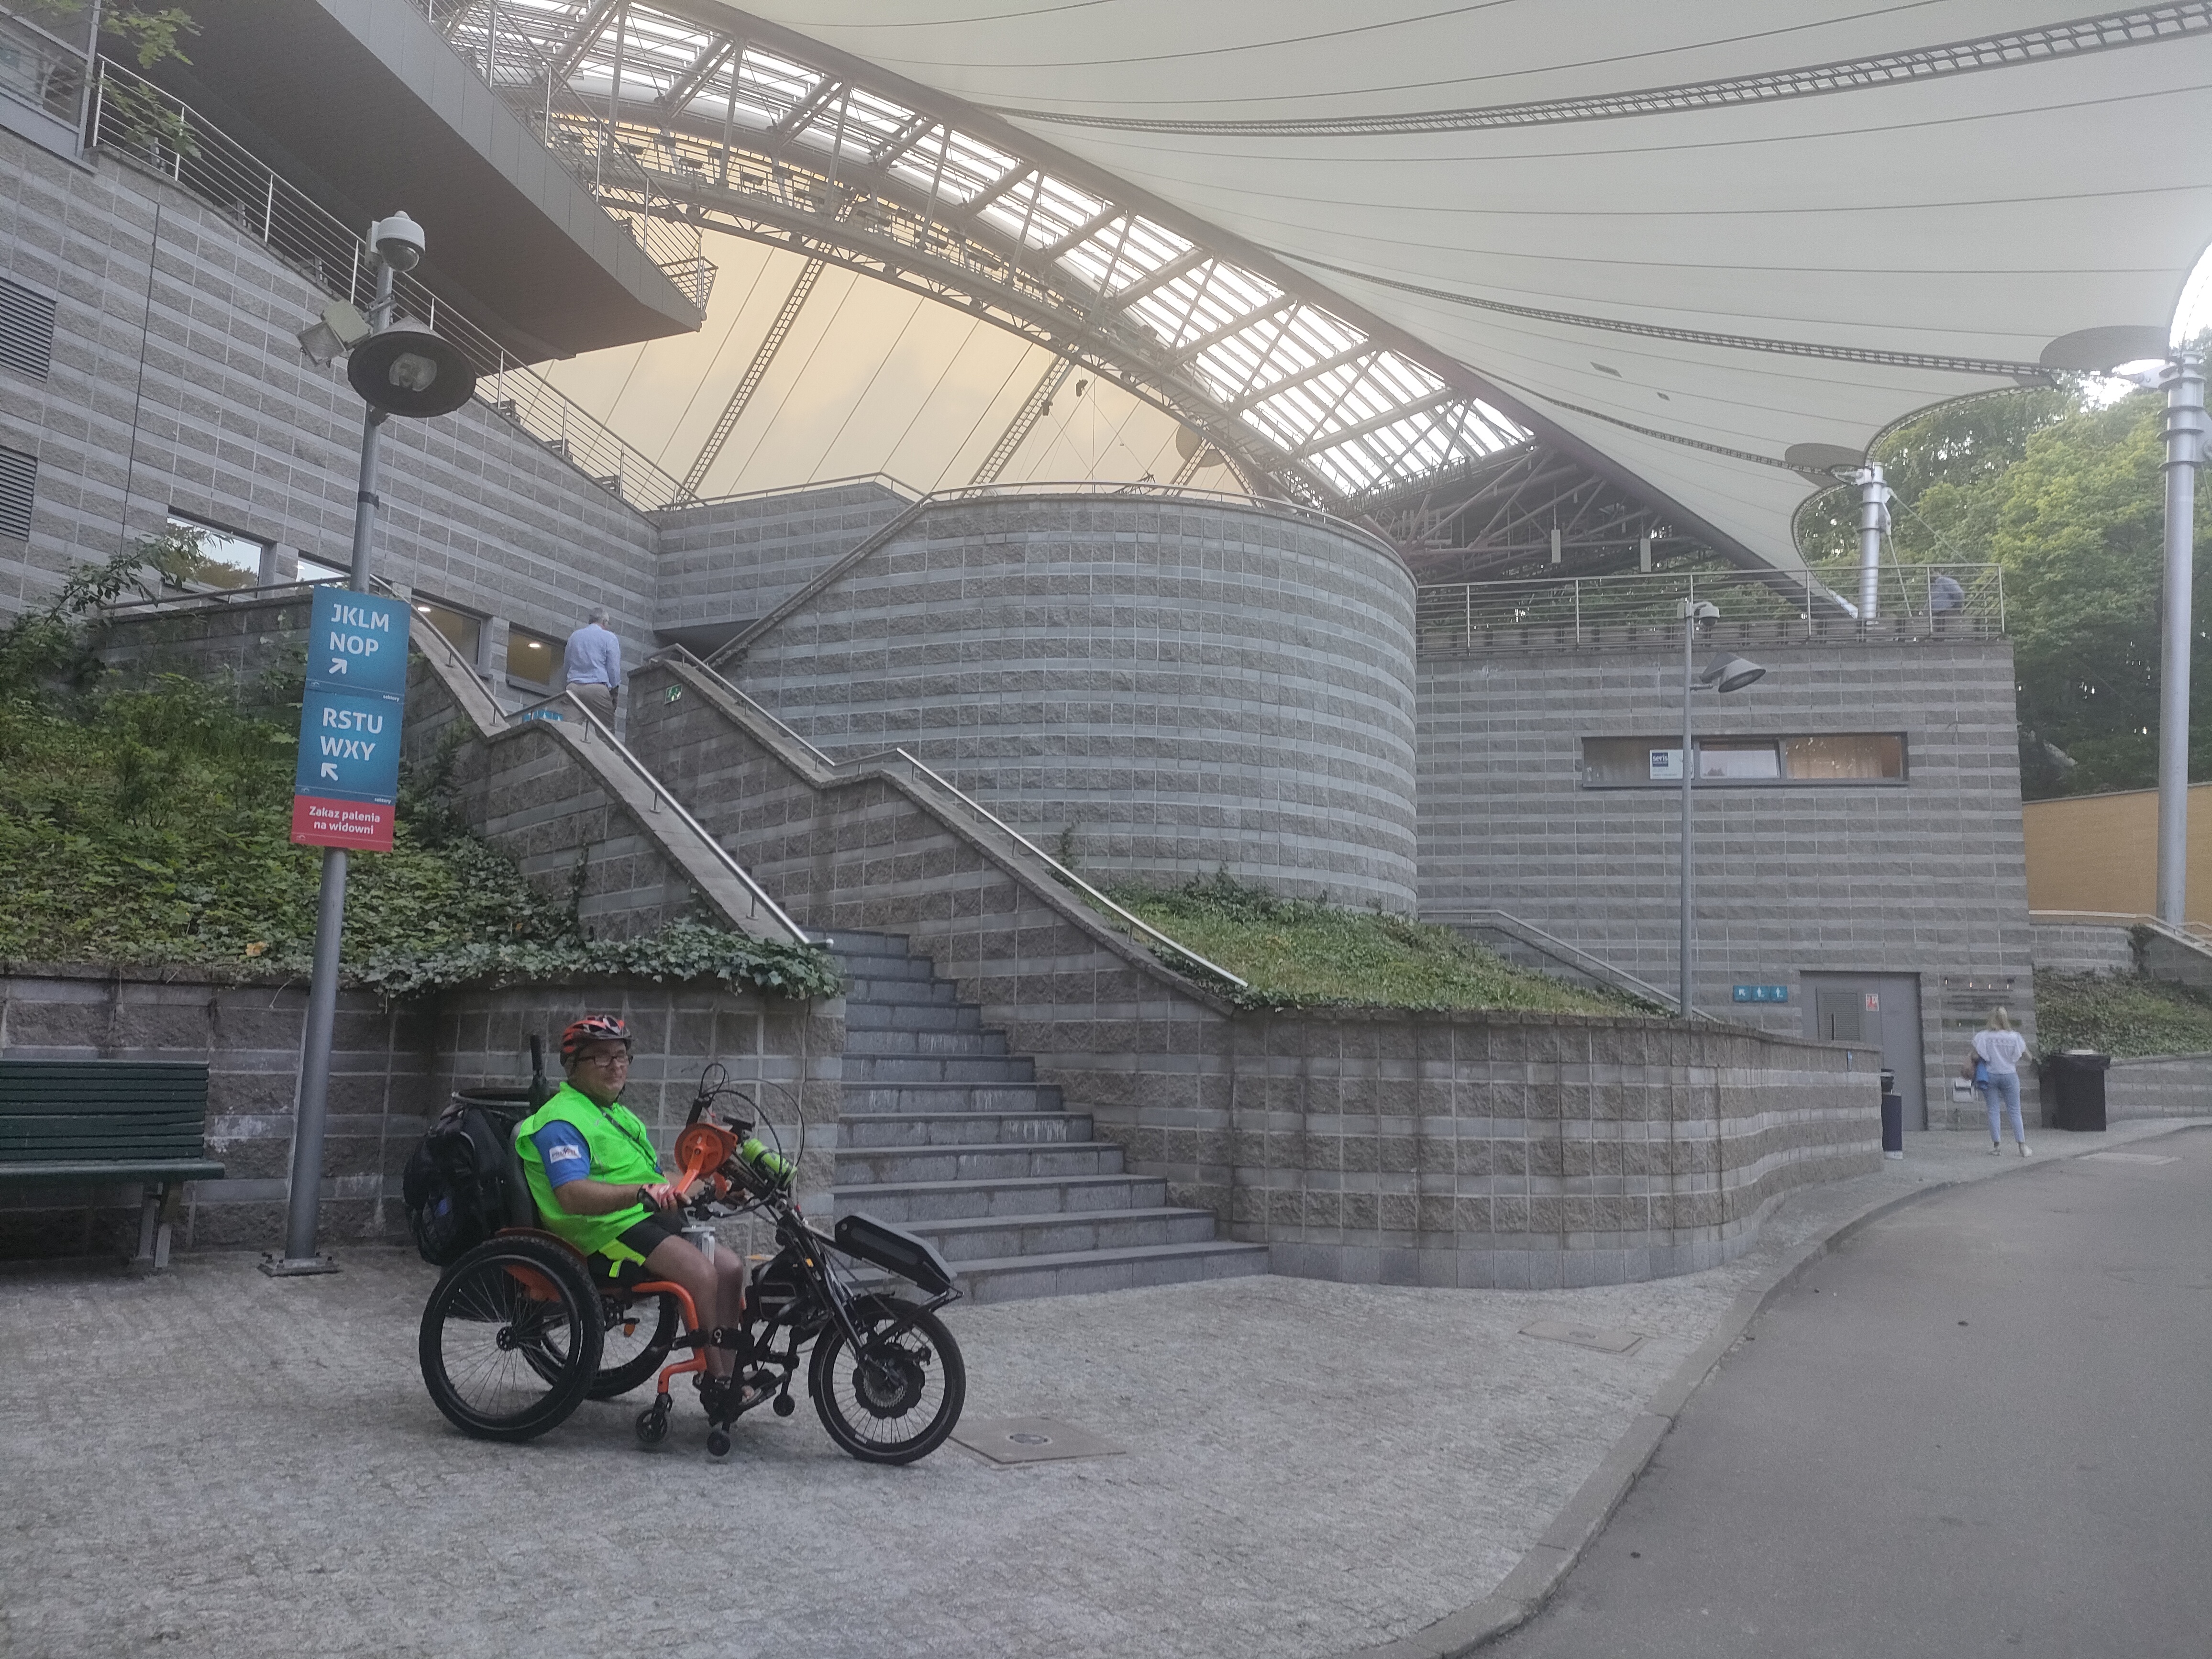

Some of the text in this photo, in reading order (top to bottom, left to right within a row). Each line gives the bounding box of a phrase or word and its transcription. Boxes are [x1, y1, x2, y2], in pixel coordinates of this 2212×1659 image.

[331, 603, 389, 632] JKLM
[330, 631, 379, 657] NOP
[323, 707, 383, 734] RSTU
[320, 735, 376, 762] WXY
[309, 806, 380, 823] Zakaz palenia
[314, 821, 374, 835] na widowni
